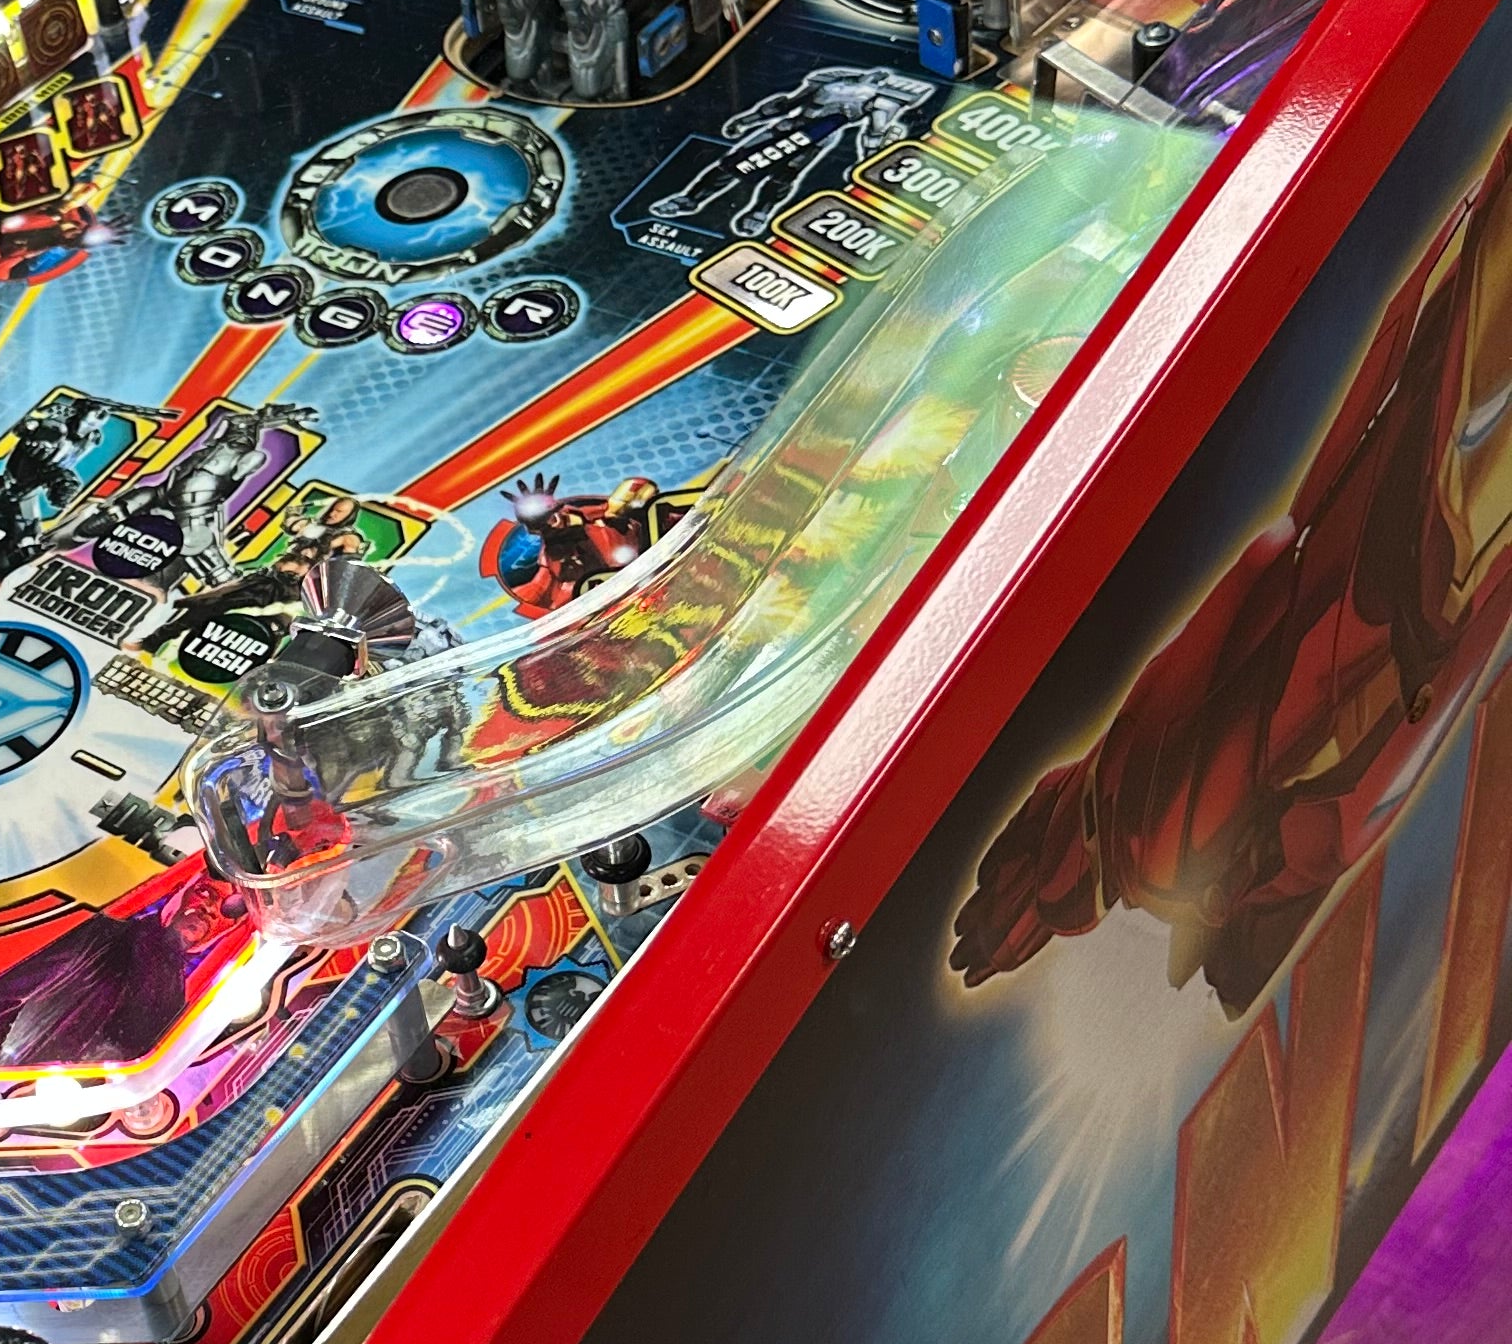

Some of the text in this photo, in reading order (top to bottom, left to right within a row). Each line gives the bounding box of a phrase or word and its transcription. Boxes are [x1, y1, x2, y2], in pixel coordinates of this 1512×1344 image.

[34, 72, 69, 102] MAN
[735, 132, 812, 175] DRONE
[636, 234, 705, 259] ASSAULT
[648, 221, 680, 240] SEA
[807, 210, 898, 266] 200K
[171, 198, 213, 223] M
[198, 246, 238, 270] O
[247, 283, 293, 308] N
[317, 303, 367, 331] G
[503, 295, 558, 326] R
[729, 262, 813, 312] 100K
[98, 538, 163, 573] MONGER
[111, 524, 179, 559] IRON
[38, 559, 149, 620] IRON
[16, 583, 128, 644] MONGER
[201, 620, 271, 657] WHIP
[184, 639, 255, 677] LASH
